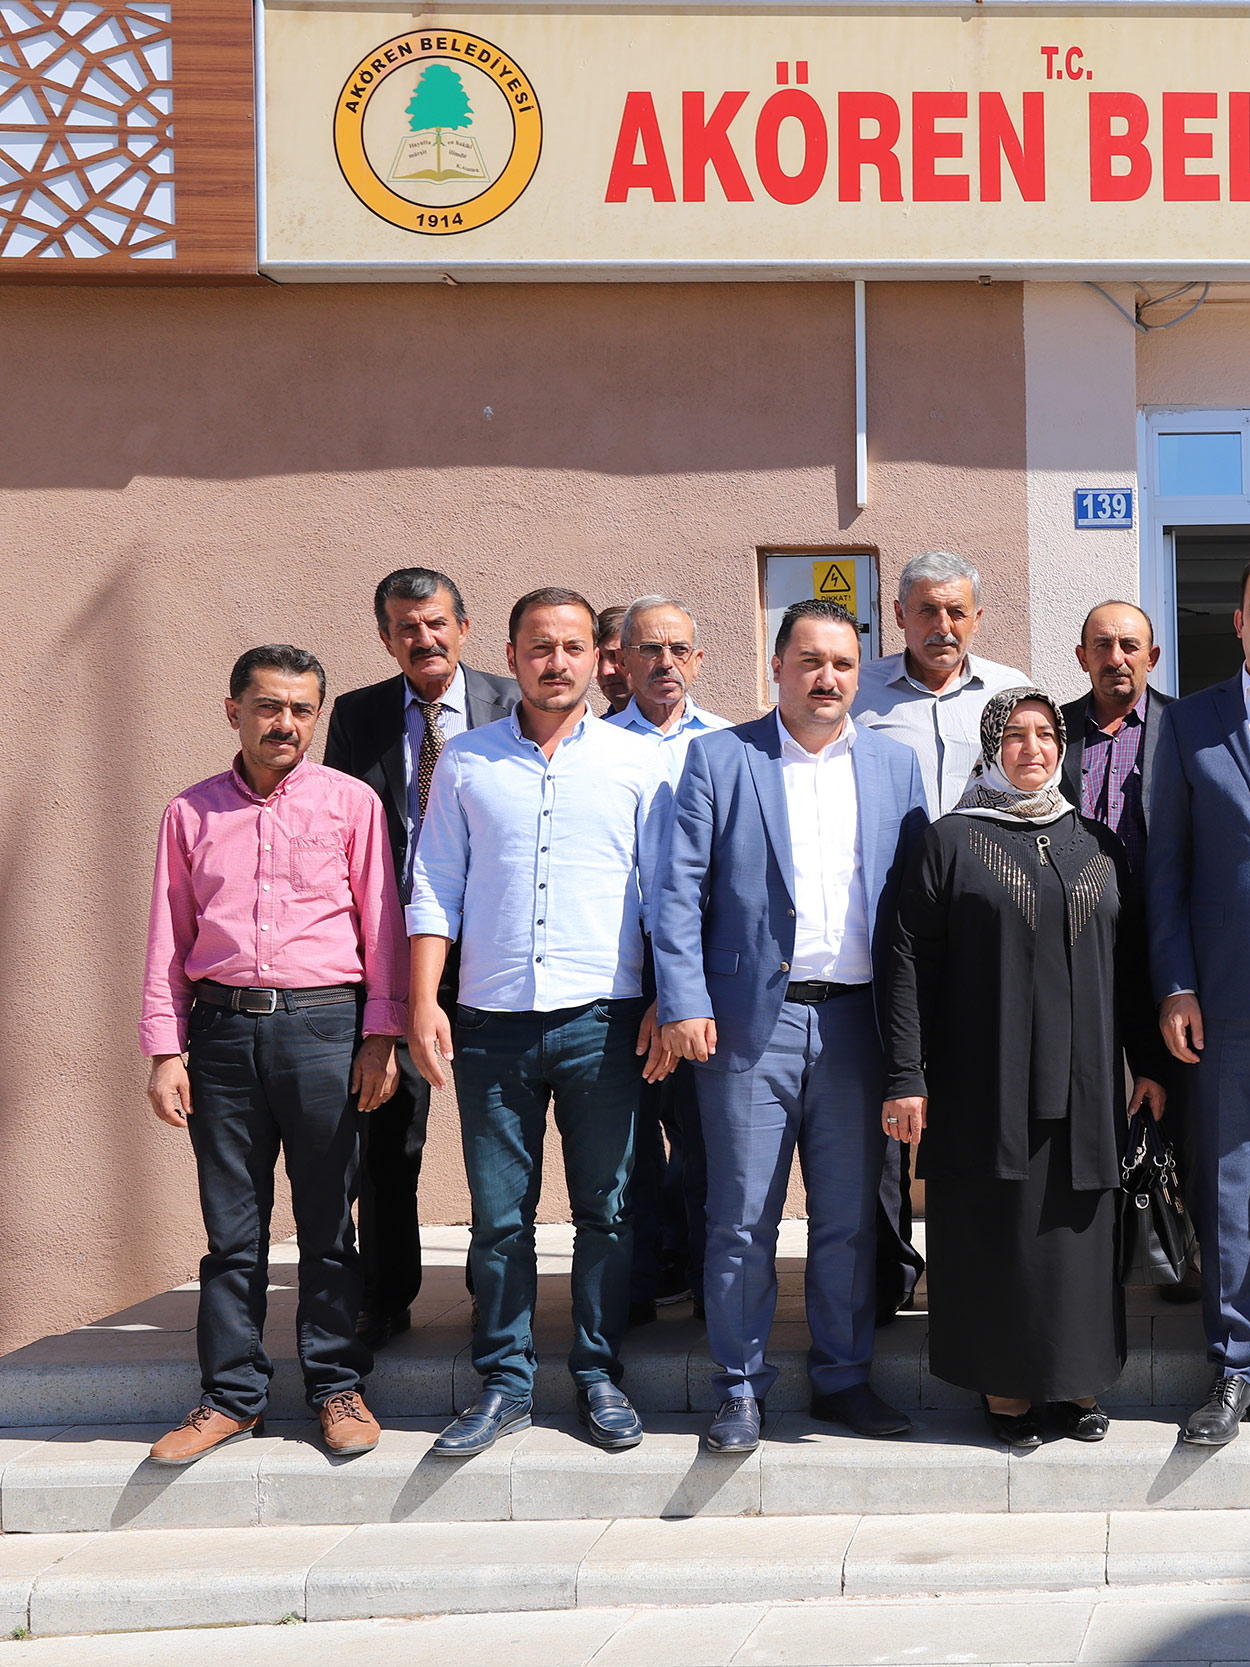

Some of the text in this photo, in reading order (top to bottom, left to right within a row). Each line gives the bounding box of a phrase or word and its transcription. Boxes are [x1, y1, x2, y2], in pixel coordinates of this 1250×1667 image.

[345, 37, 534, 114] AKÖREN BELEDİYESİ
[1041, 45, 1093, 80] T.C.
[604, 60, 1046, 205] AKÖREN
[416, 212, 464, 228] 1914
[1082, 494, 1126, 519] 139
